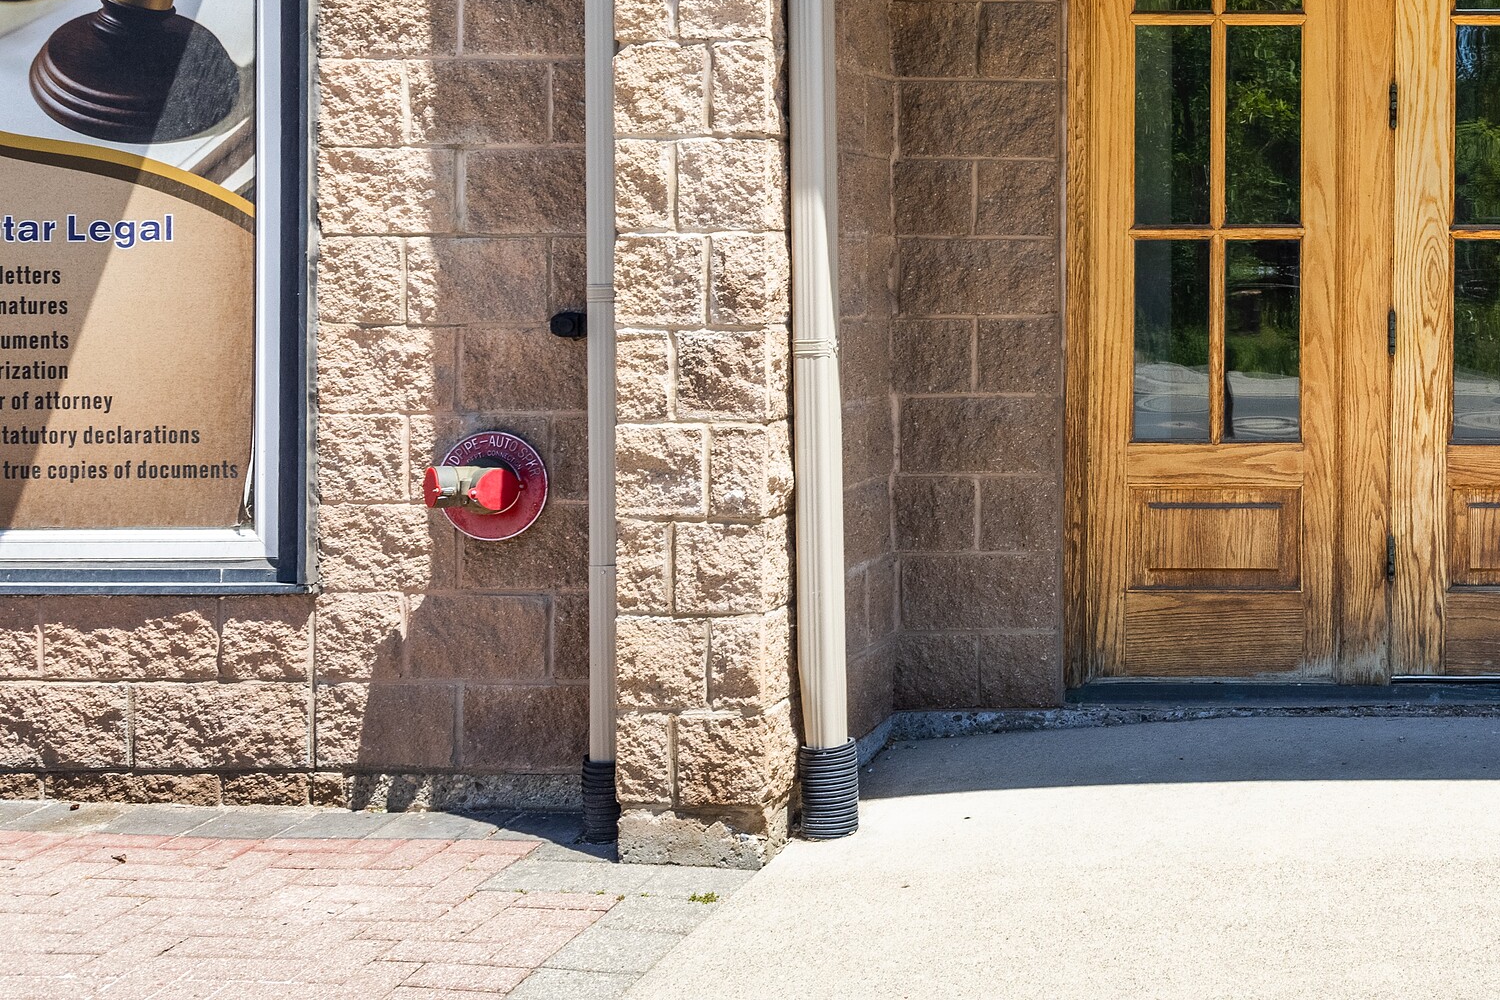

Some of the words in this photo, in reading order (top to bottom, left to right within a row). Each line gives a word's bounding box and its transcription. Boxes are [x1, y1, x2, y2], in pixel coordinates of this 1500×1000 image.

[0, 214, 56, 242] tar
[66, 213, 174, 249] Legal
[0, 265, 61, 284] letters
[0, 331, 69, 349] uments
[11, 391, 29, 410] of
[34, 391, 113, 413] attorney
[83, 425, 201, 444] declarations
[3, 460, 41, 479] true
[47, 460, 108, 483] copies
[114, 460, 132, 479] of
[137, 460, 239, 479] documents
[517, 447, 541, 477] SPKR
